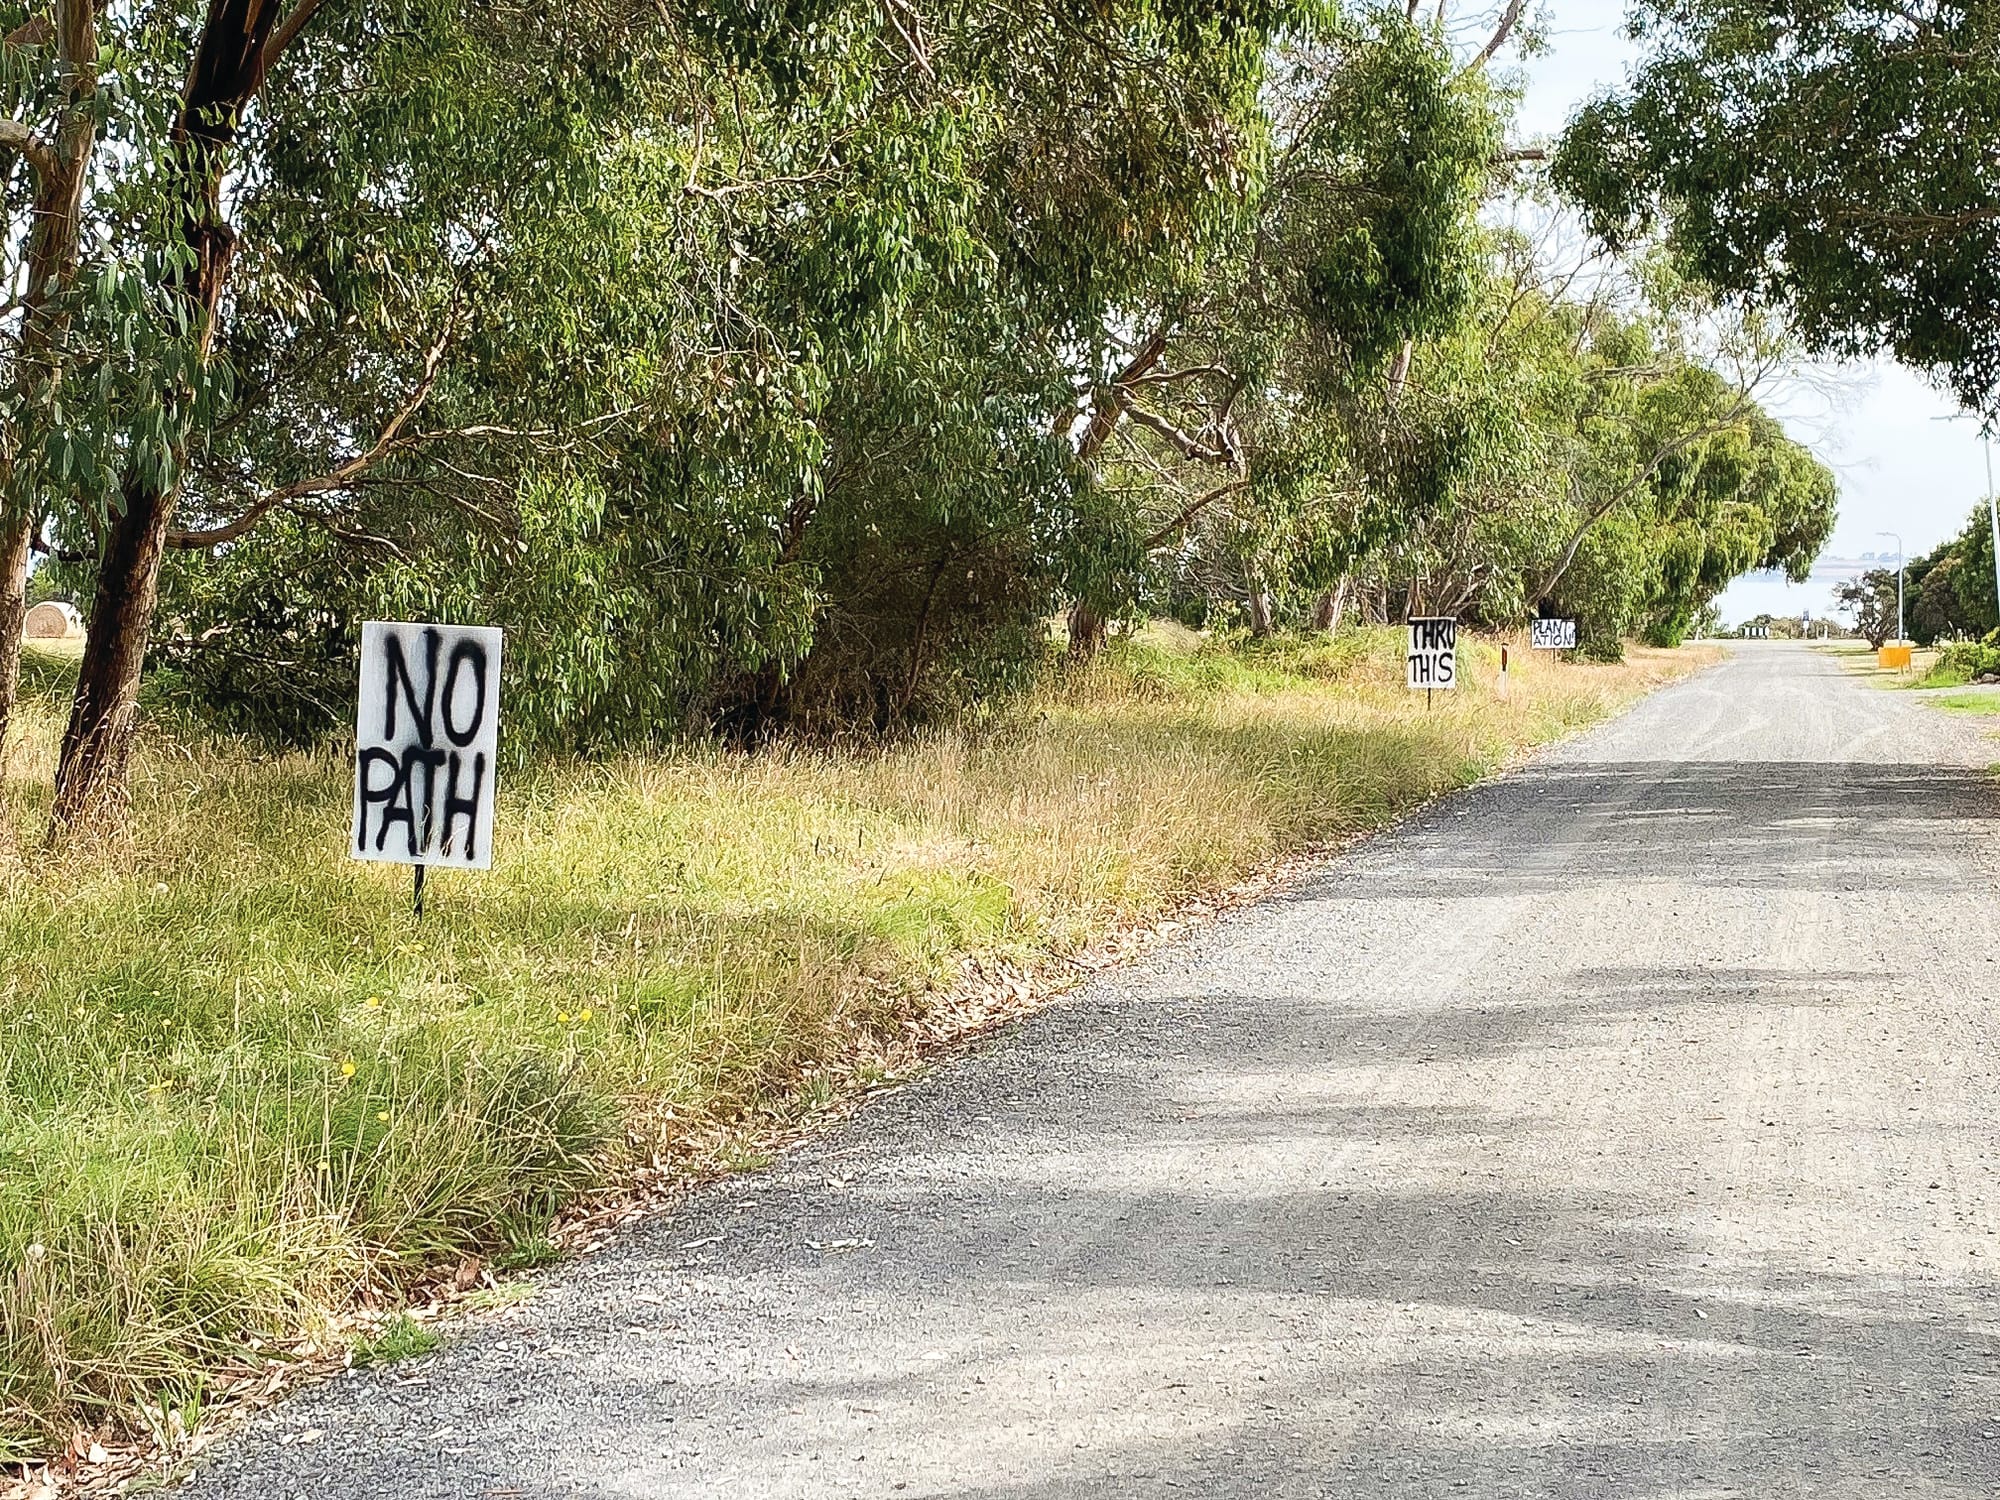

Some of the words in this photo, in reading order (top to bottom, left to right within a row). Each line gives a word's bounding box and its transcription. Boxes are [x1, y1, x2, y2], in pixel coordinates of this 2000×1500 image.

[1408, 652, 1453, 683] THIS
[1409, 620, 1456, 650] THRU
[385, 628, 486, 749] NO
[358, 746, 485, 860] PATH
